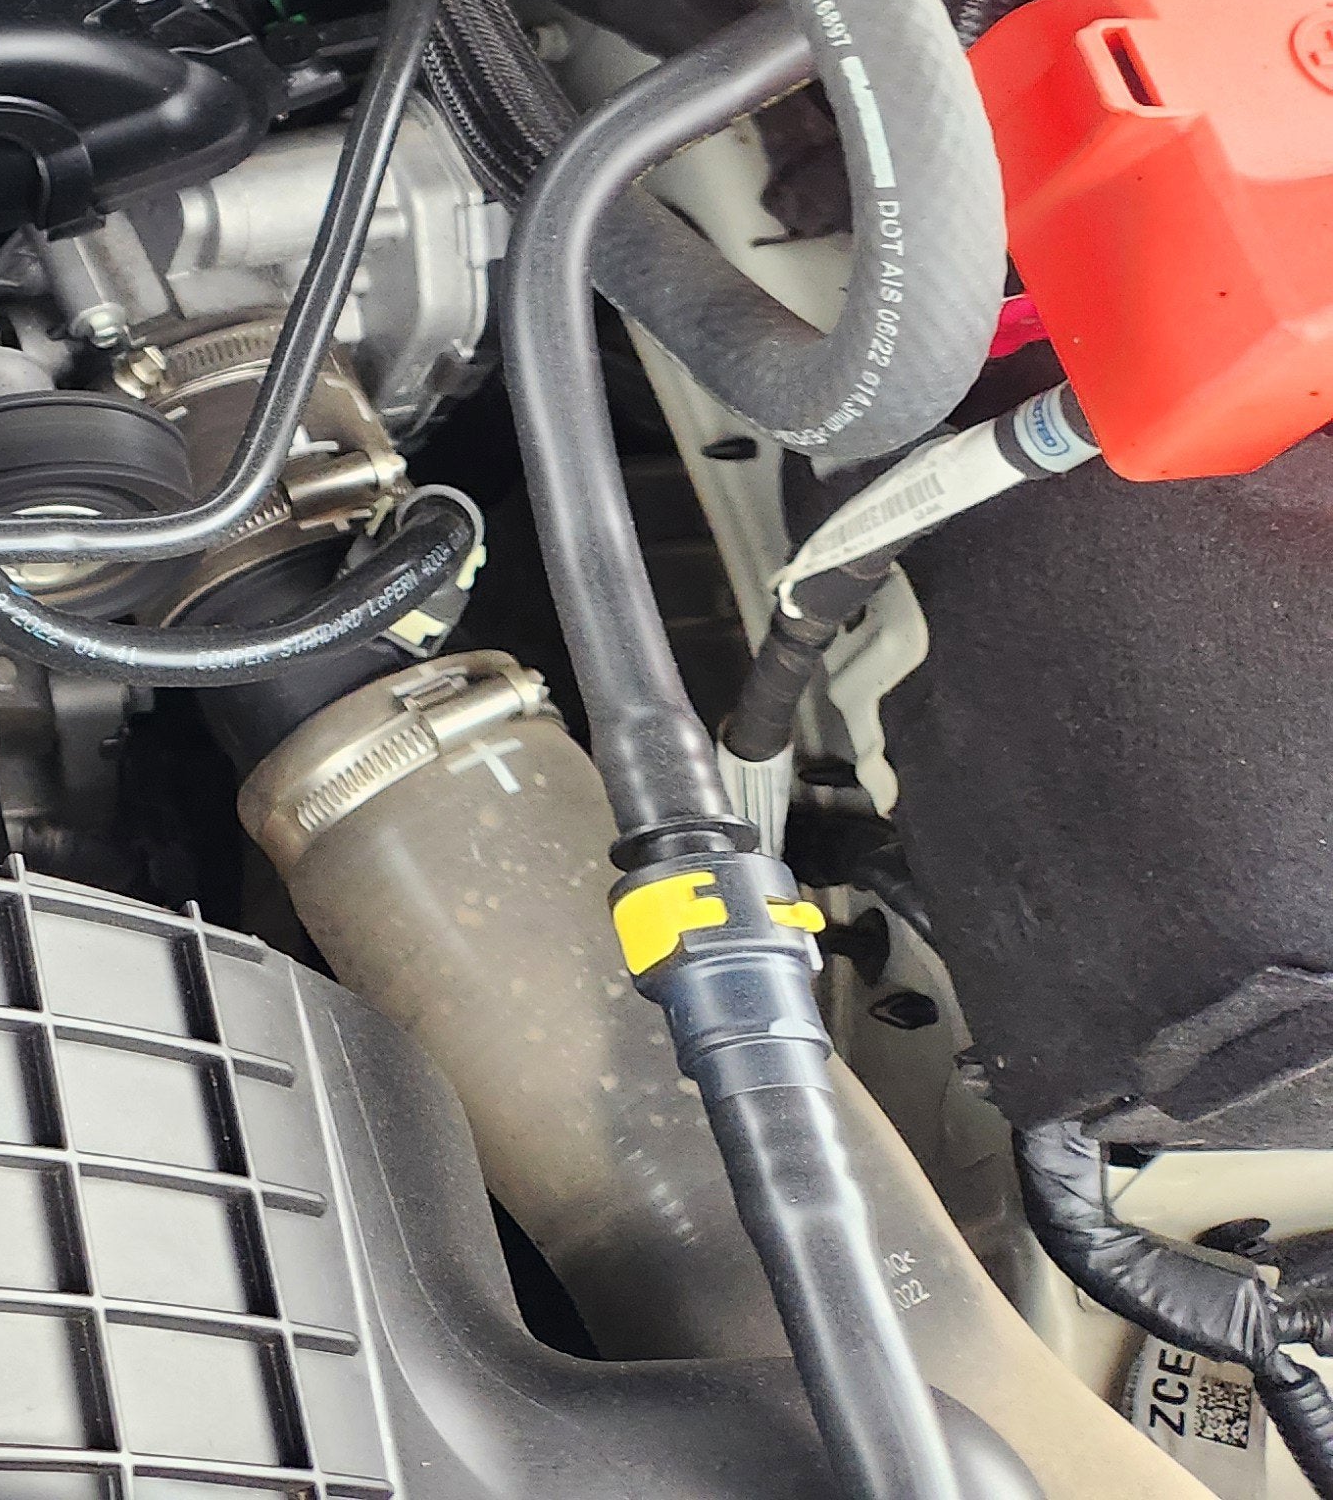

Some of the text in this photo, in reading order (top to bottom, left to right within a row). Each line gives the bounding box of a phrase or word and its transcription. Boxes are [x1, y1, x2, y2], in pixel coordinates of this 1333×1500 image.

[877, 200, 905, 257] DOT
[880, 261, 905, 304] AIS
[867, 308, 901, 368] 06/22
[1032, 396, 1058, 449] ECTED
[279, 607, 364, 660] STANDARD
[1148, 1348, 1196, 1438] ZCE
